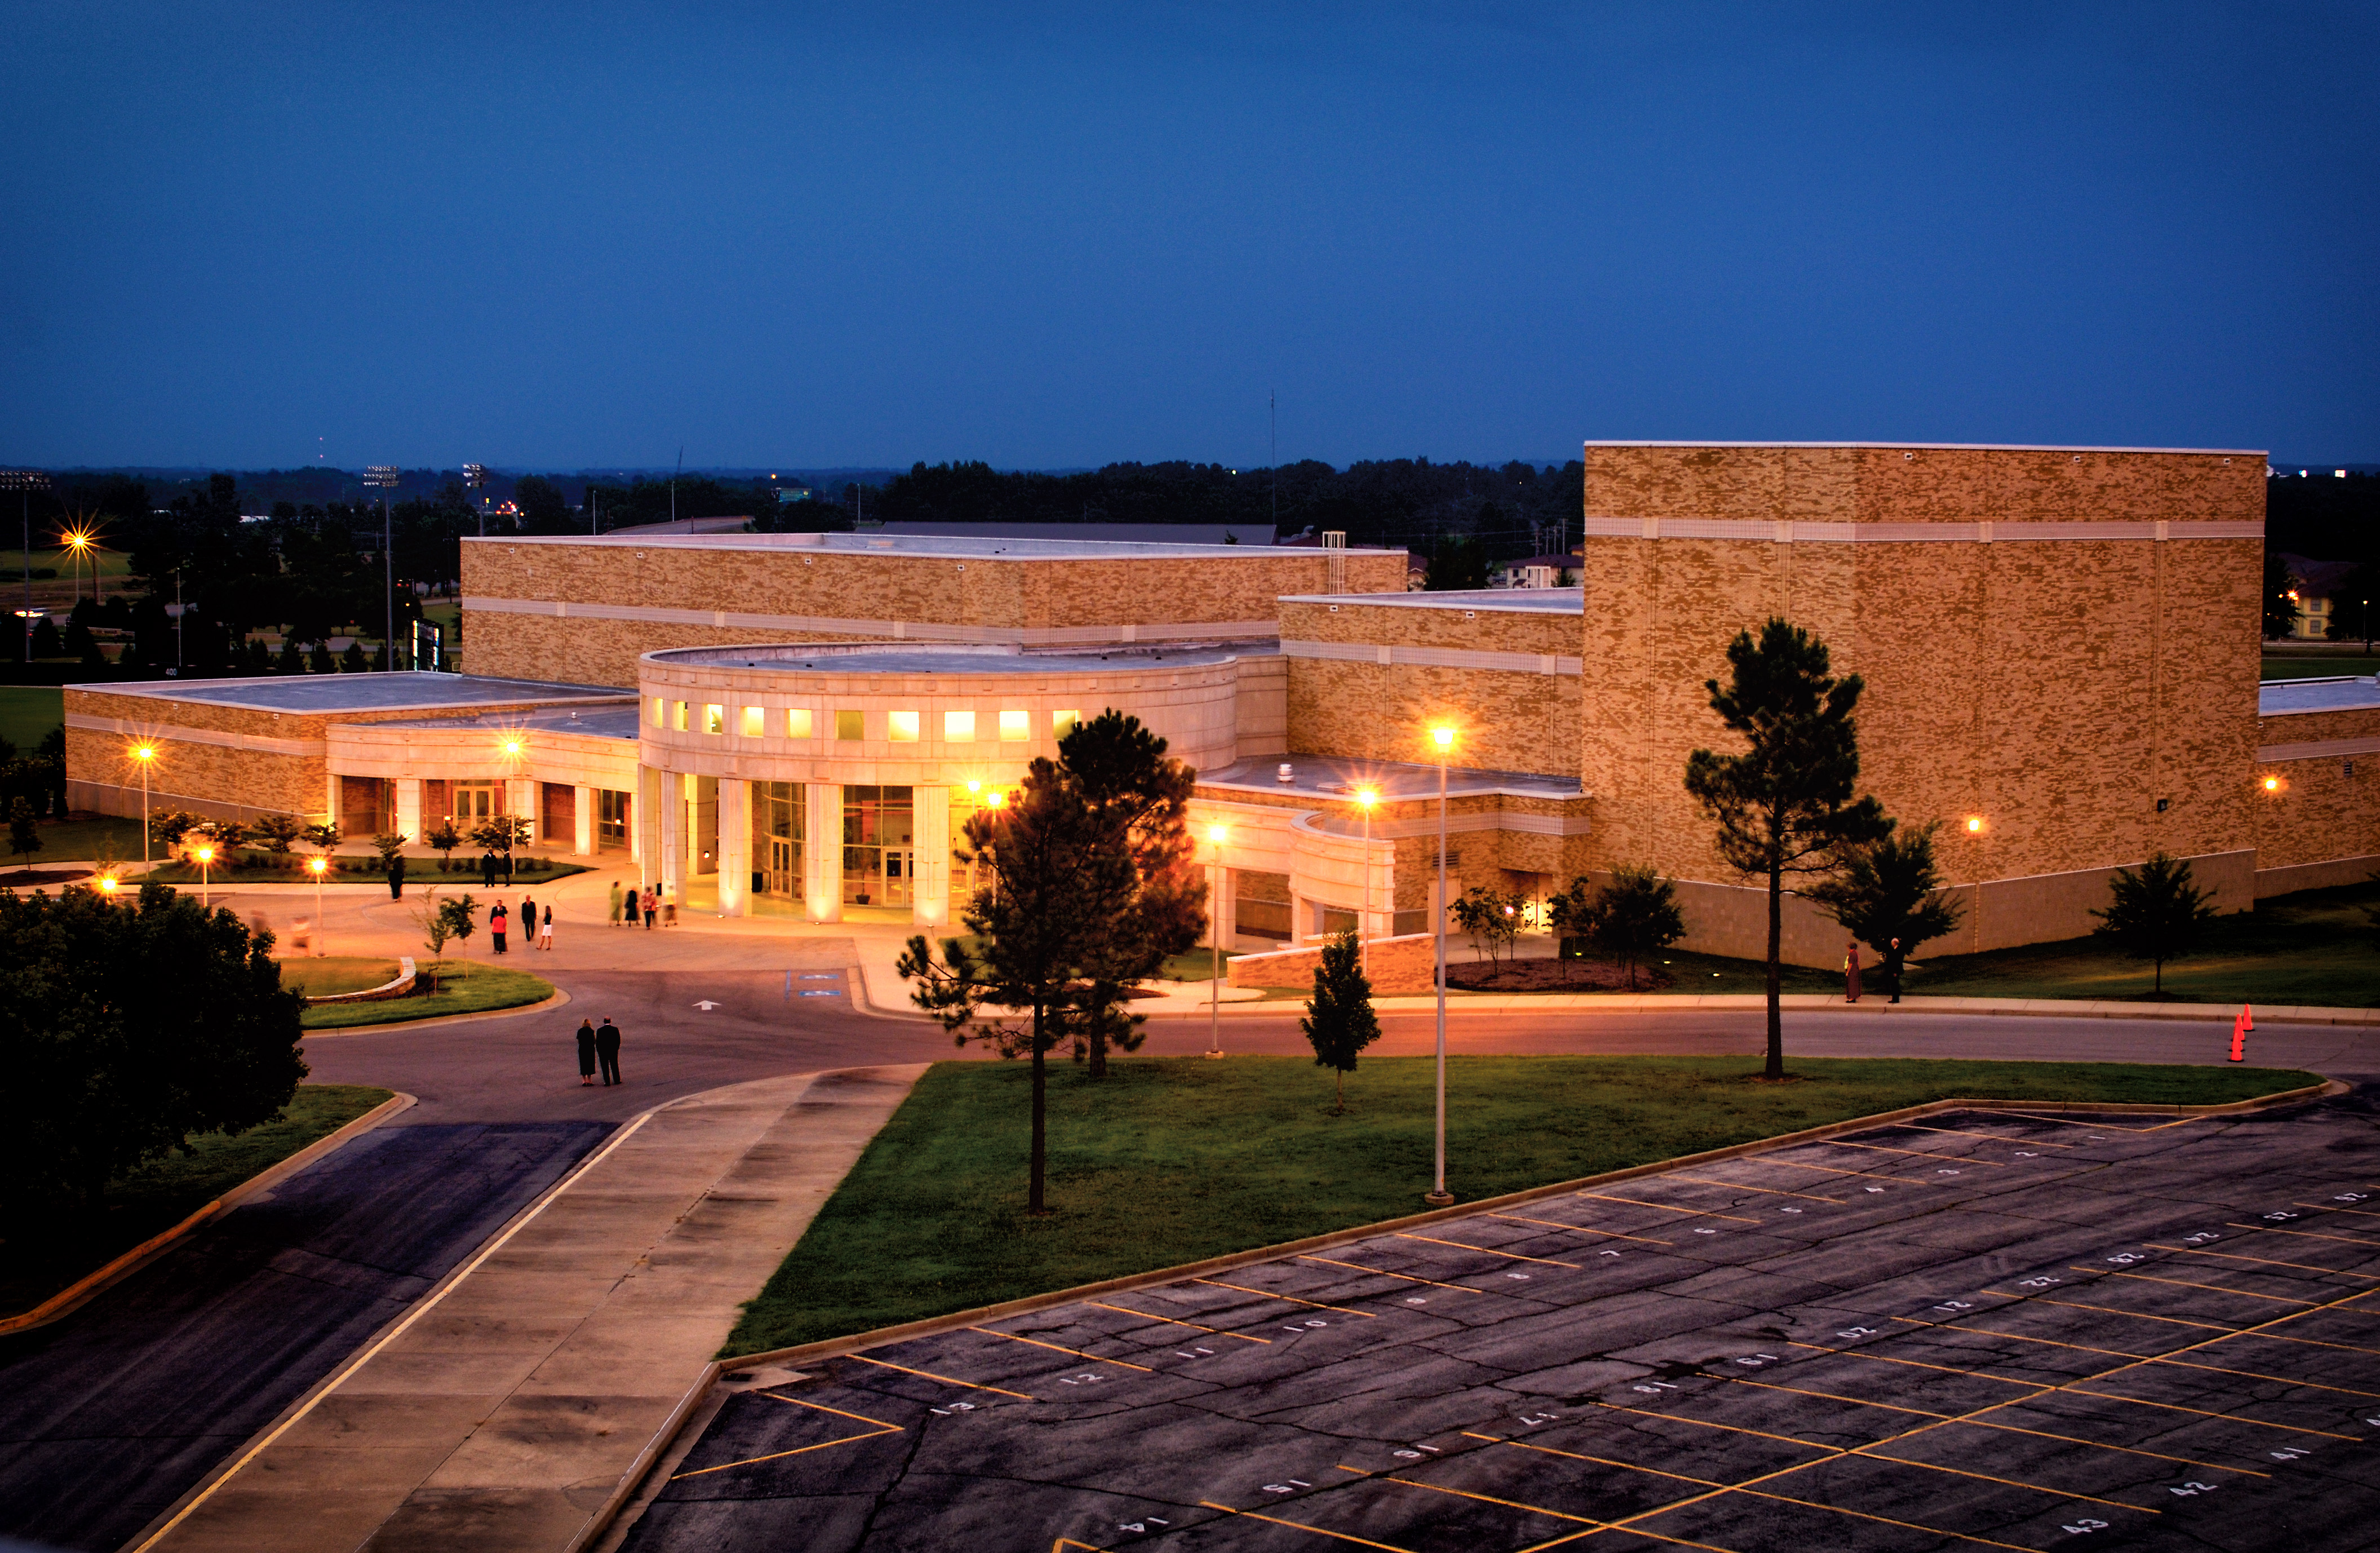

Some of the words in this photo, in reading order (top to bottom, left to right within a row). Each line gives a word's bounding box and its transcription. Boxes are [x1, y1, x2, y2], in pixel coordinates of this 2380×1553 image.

[2019, 1276, 2060, 1286] 22
[1283, 1320, 1327, 1332] 10
[1836, 1327, 1877, 1338] 20
[1176, 1347, 1214, 1358] 11
[1060, 1374, 1104, 1384] 12
[930, 1402, 975, 1414] 13
[2270, 1447, 2311, 1459] 41
[1262, 1479, 1311, 1493] 15
[2169, 1482, 2218, 1496] 42
[1119, 1517, 1169, 1532] 14
[2062, 1519, 2108, 1534] 43
